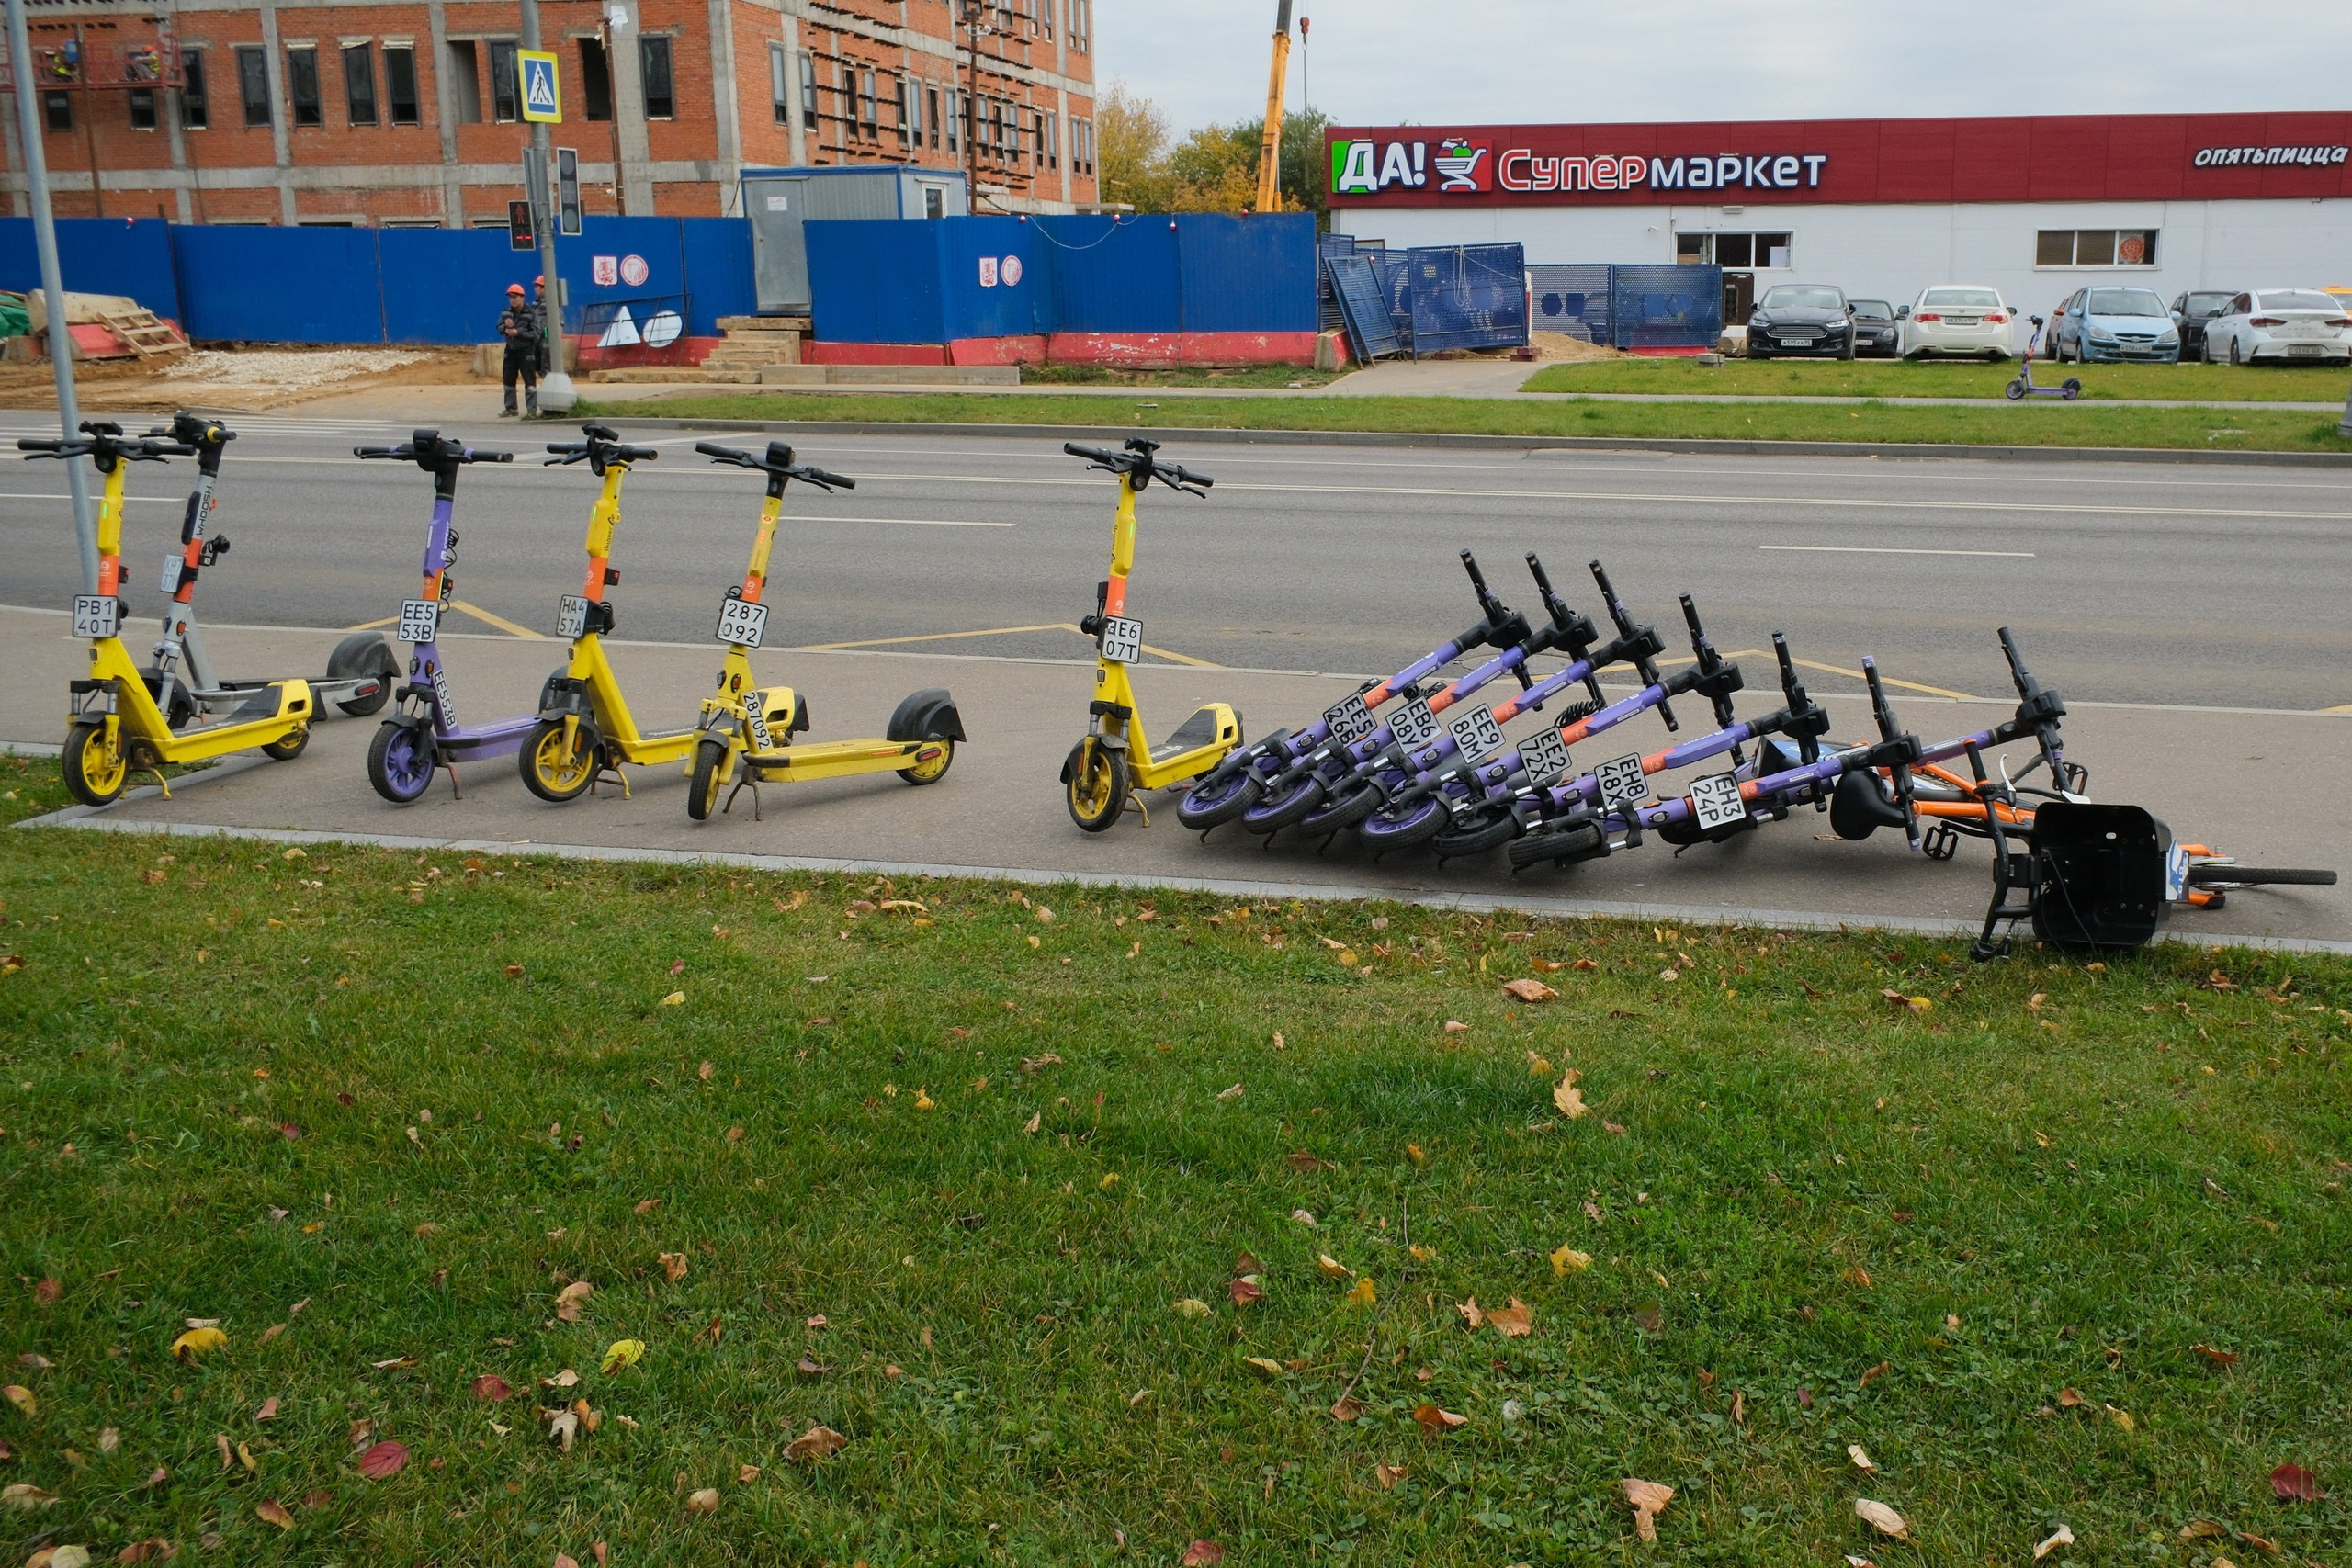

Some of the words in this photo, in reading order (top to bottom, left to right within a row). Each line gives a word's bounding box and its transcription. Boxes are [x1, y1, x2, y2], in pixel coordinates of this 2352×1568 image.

[1339, 142, 1426, 191] ДА!
[1499, 149, 1826, 191] Супермаркет
[197, 485, 212, 536] WHOOSH
[77, 600, 112, 615] РВ1
[77, 619, 113, 634] 40Т
[403, 604, 434, 621] ЕЕ5
[560, 617, 582, 635] 57А
[727, 603, 763, 623] 287
[401, 623, 432, 640] 53В
[722, 622, 757, 643] 092
[1106, 640, 1137, 659] 07Т
[434, 671, 456, 727] ЕЕ553В
[1344, 696, 1374, 734] ЕЕ5
[743, 692, 769, 750] 287092
[1327, 708, 1356, 746] 26В
[1391, 714, 1420, 746] 08У
[1408, 700, 1437, 738] ЕВ6
[1471, 707, 1499, 745] ЕЕ9
[1453, 720, 1483, 760] 80М
[1540, 730, 1566, 773] ЕЕ2
[1521, 739, 1550, 781] 72Х
[1619, 758, 1645, 797] ЕН8
[1601, 765, 1625, 806] 48Х
[1693, 784, 1720, 823] 24Р
[1715, 778, 1741, 817] ЕН3
